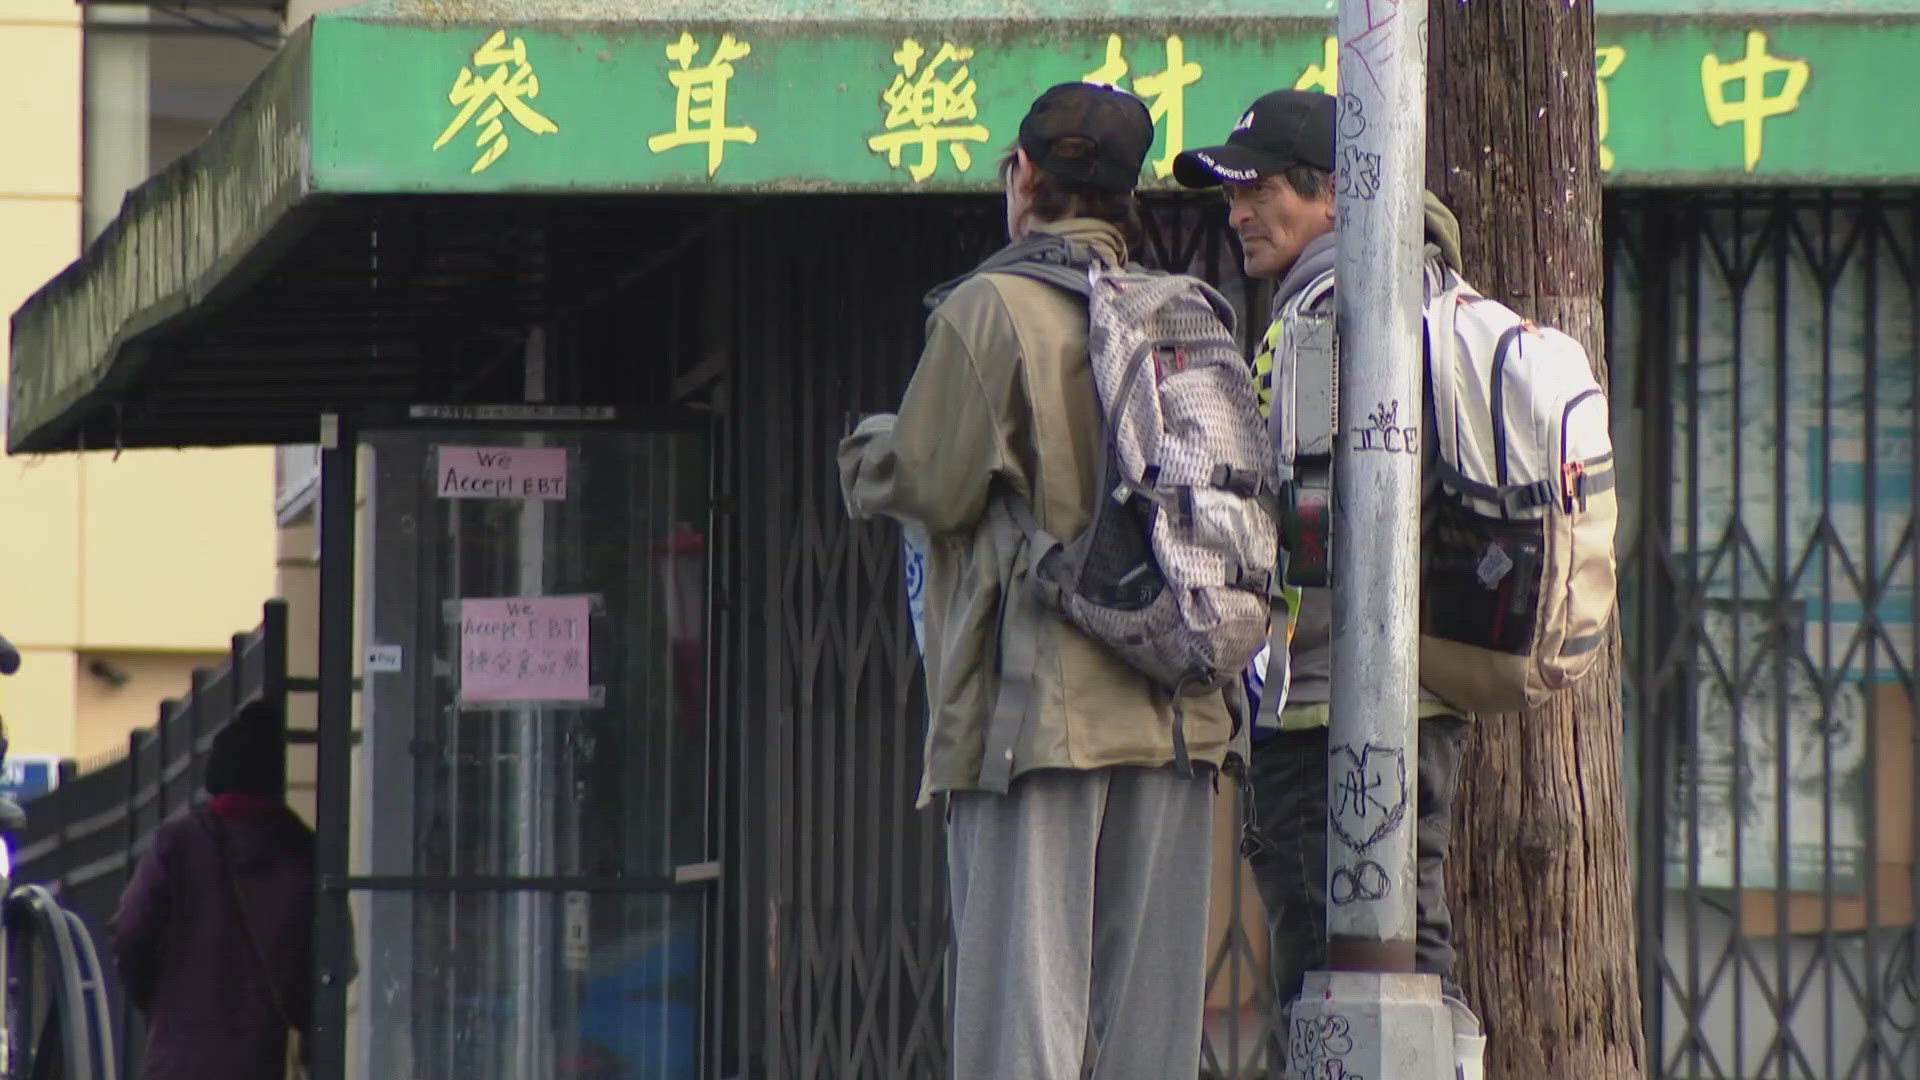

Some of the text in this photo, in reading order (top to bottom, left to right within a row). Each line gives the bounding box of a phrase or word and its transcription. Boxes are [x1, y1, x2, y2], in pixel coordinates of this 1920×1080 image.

[1213, 163, 1259, 181] ANGELES
[476, 450, 512, 470] We
[443, 467, 513, 497] Accept
[506, 599, 534, 616] We
[464, 617, 518, 640] Accept
